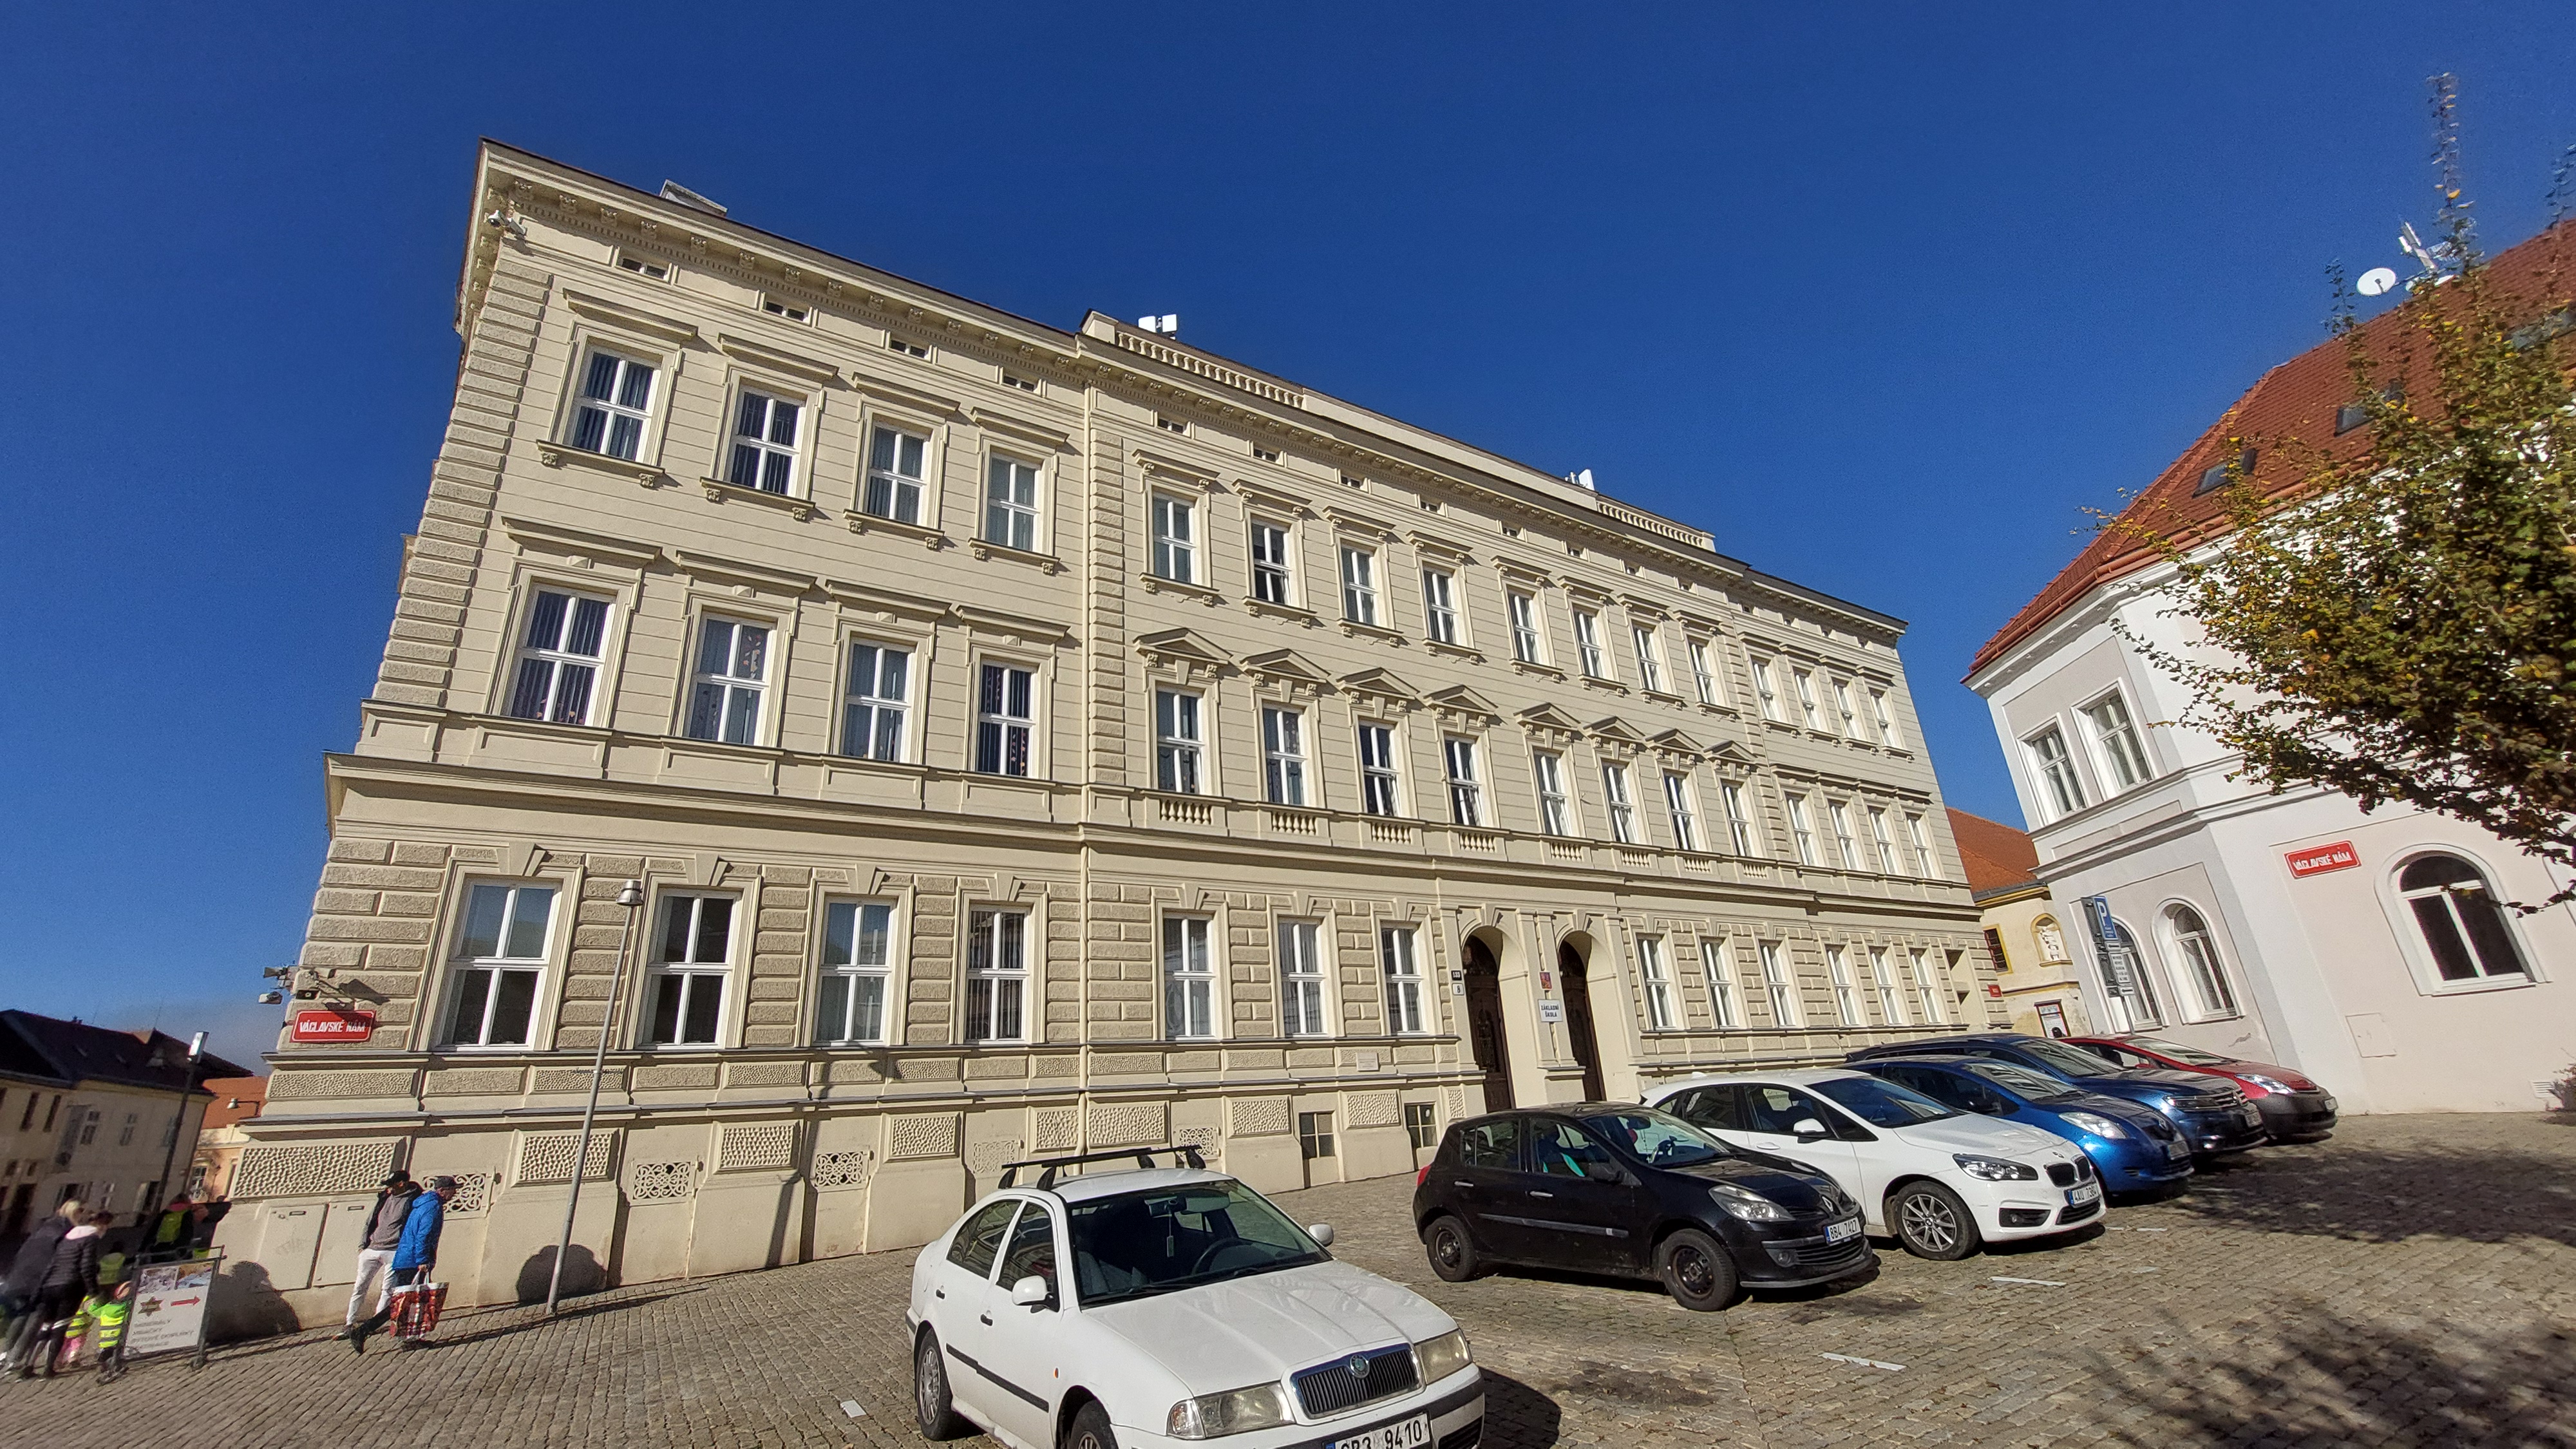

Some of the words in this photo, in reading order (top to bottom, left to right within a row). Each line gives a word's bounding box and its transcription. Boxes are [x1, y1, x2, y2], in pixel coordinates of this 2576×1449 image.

[2293, 853, 2333, 870] VÁCLAVSKÉ
[299, 1019, 345, 1033] VÁCLAVSKÉ
[1830, 1225, 1842, 1240] 8B4
[1385, 1420, 1422, 1449] 9410
